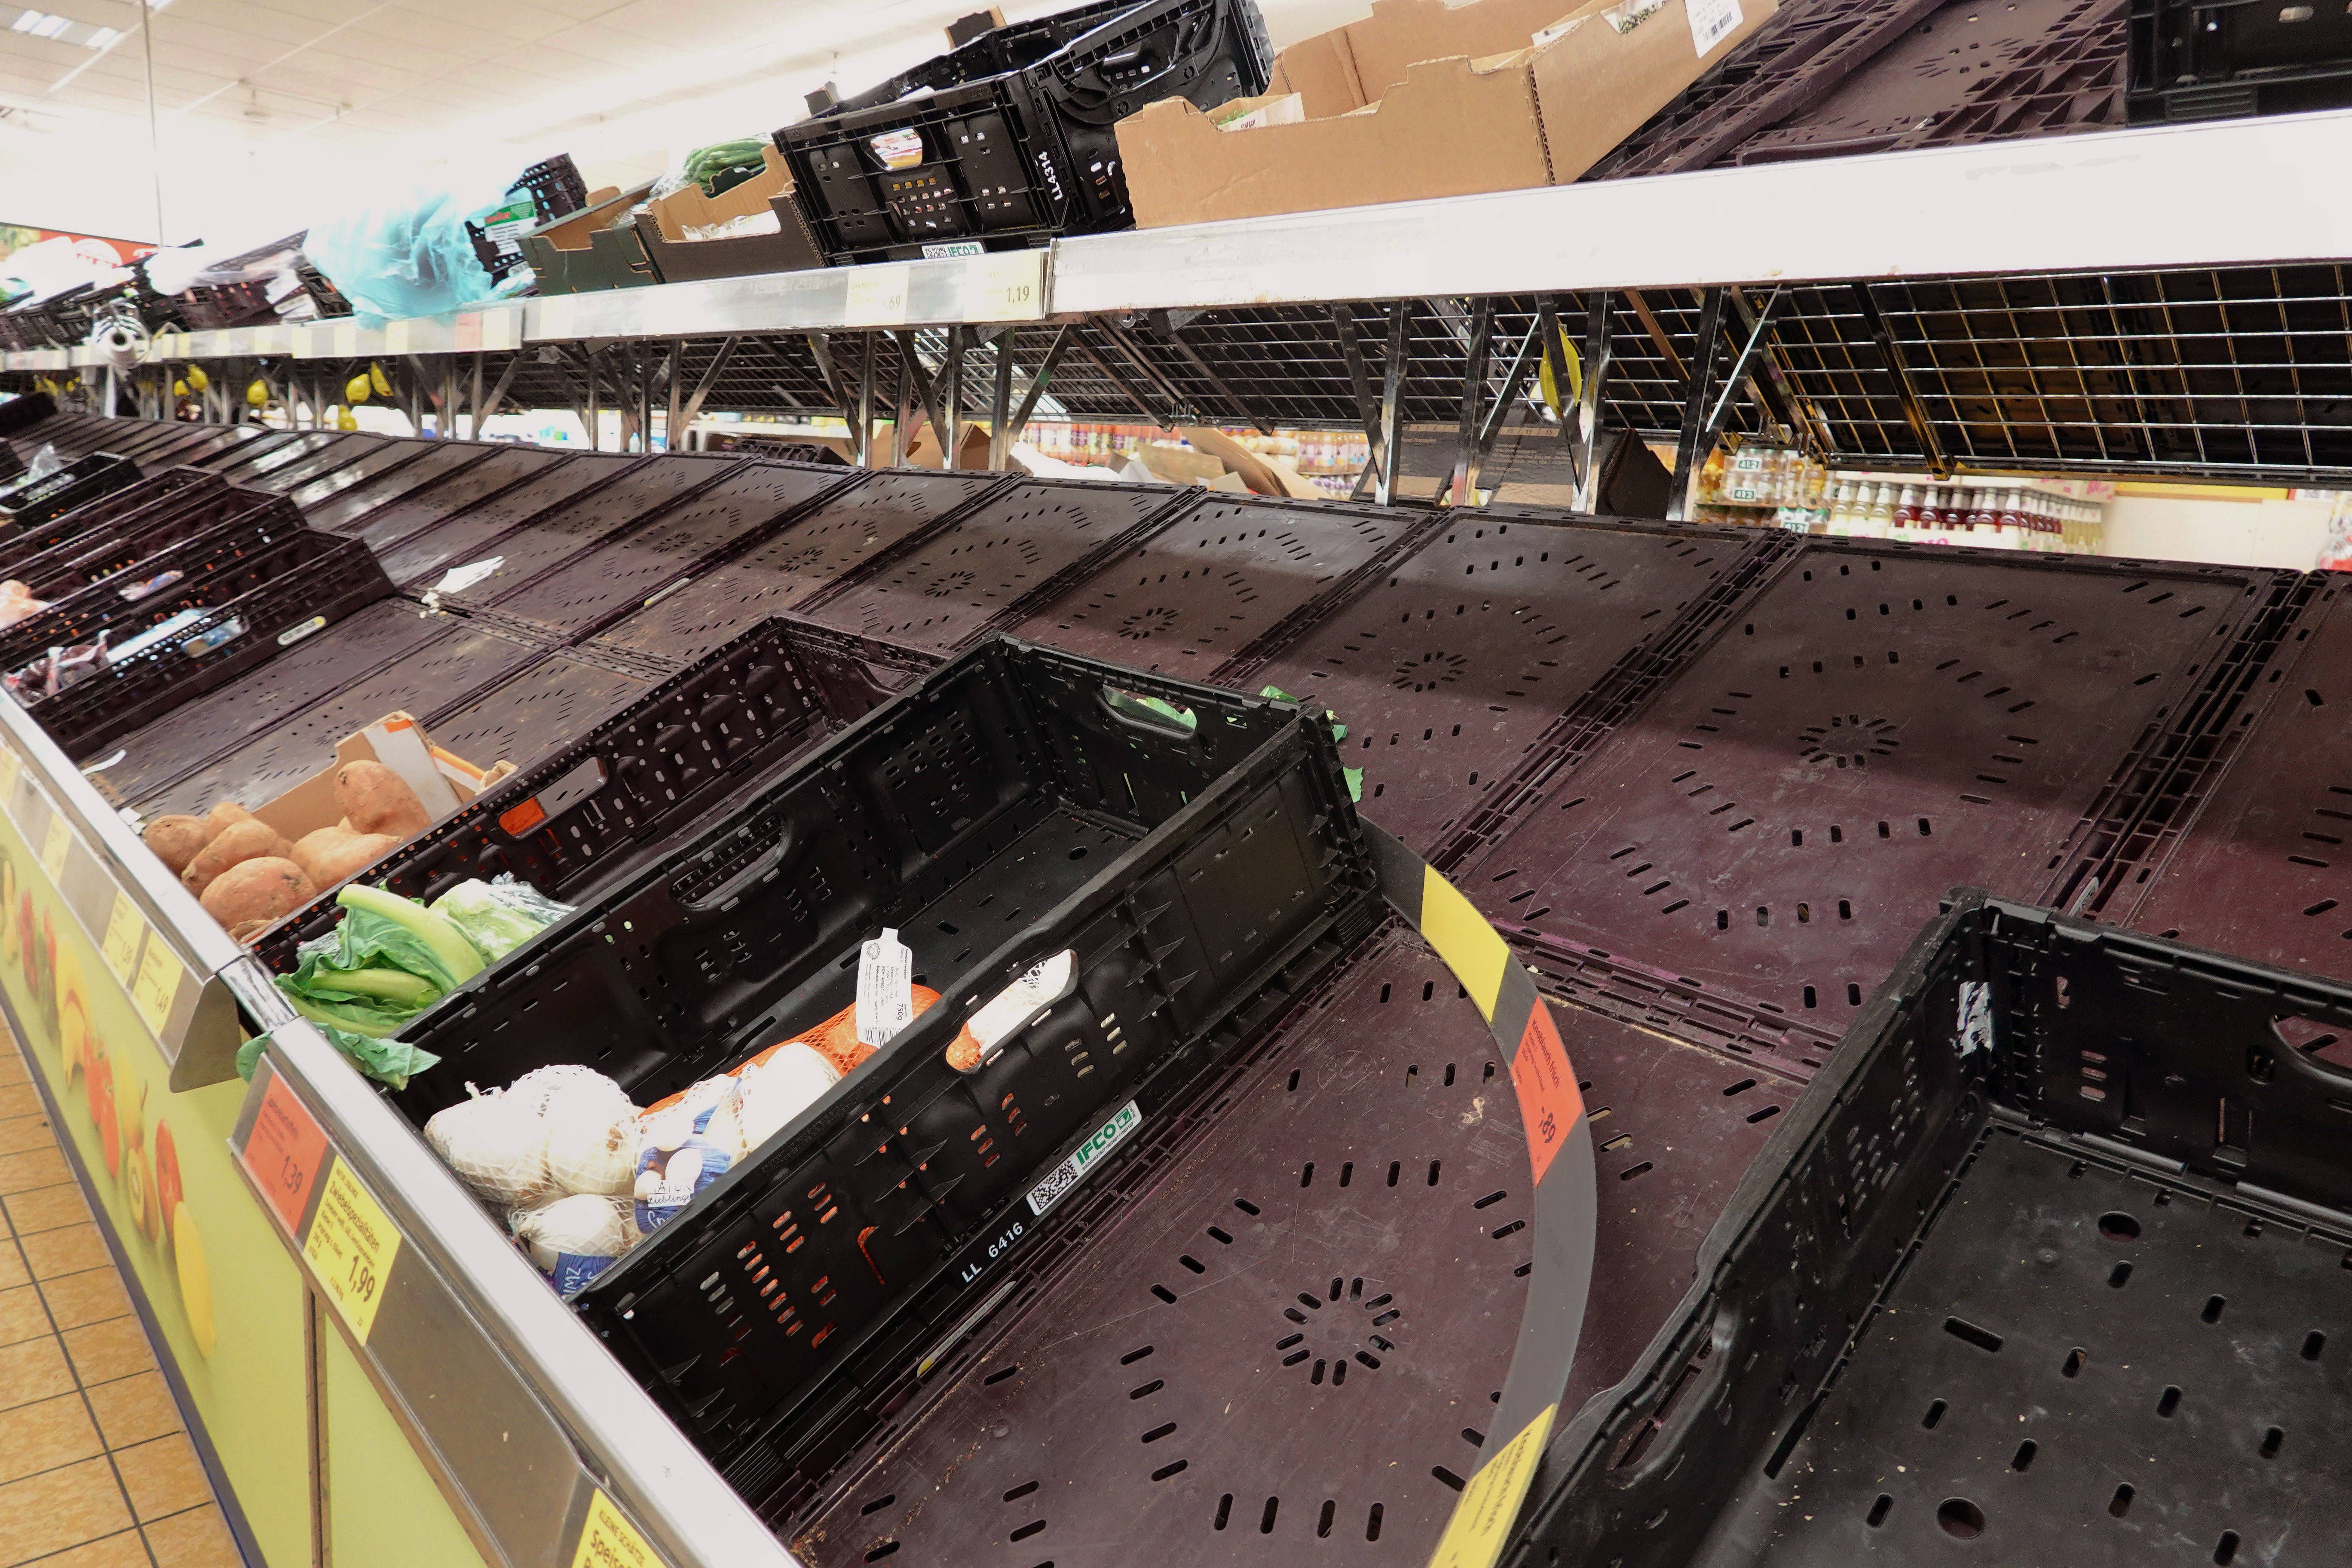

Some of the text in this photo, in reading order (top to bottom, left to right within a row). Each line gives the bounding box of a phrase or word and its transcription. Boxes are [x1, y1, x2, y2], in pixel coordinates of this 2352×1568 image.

[1038, 151, 1063, 201] LL4314
[947, 246, 970, 256] IFCO
[1007, 285, 1029, 305] 1,19
[1531, 1018, 1560, 1090] Knoblauch frisch
[1076, 1123, 1117, 1165] IFCO
[281, 1156, 303, 1195] 1,39
[329, 1180, 380, 1253] Zwiebelspezialitäten
[961, 1222, 1024, 1283] LL 6416
[348, 1255, 376, 1302] 1,99
